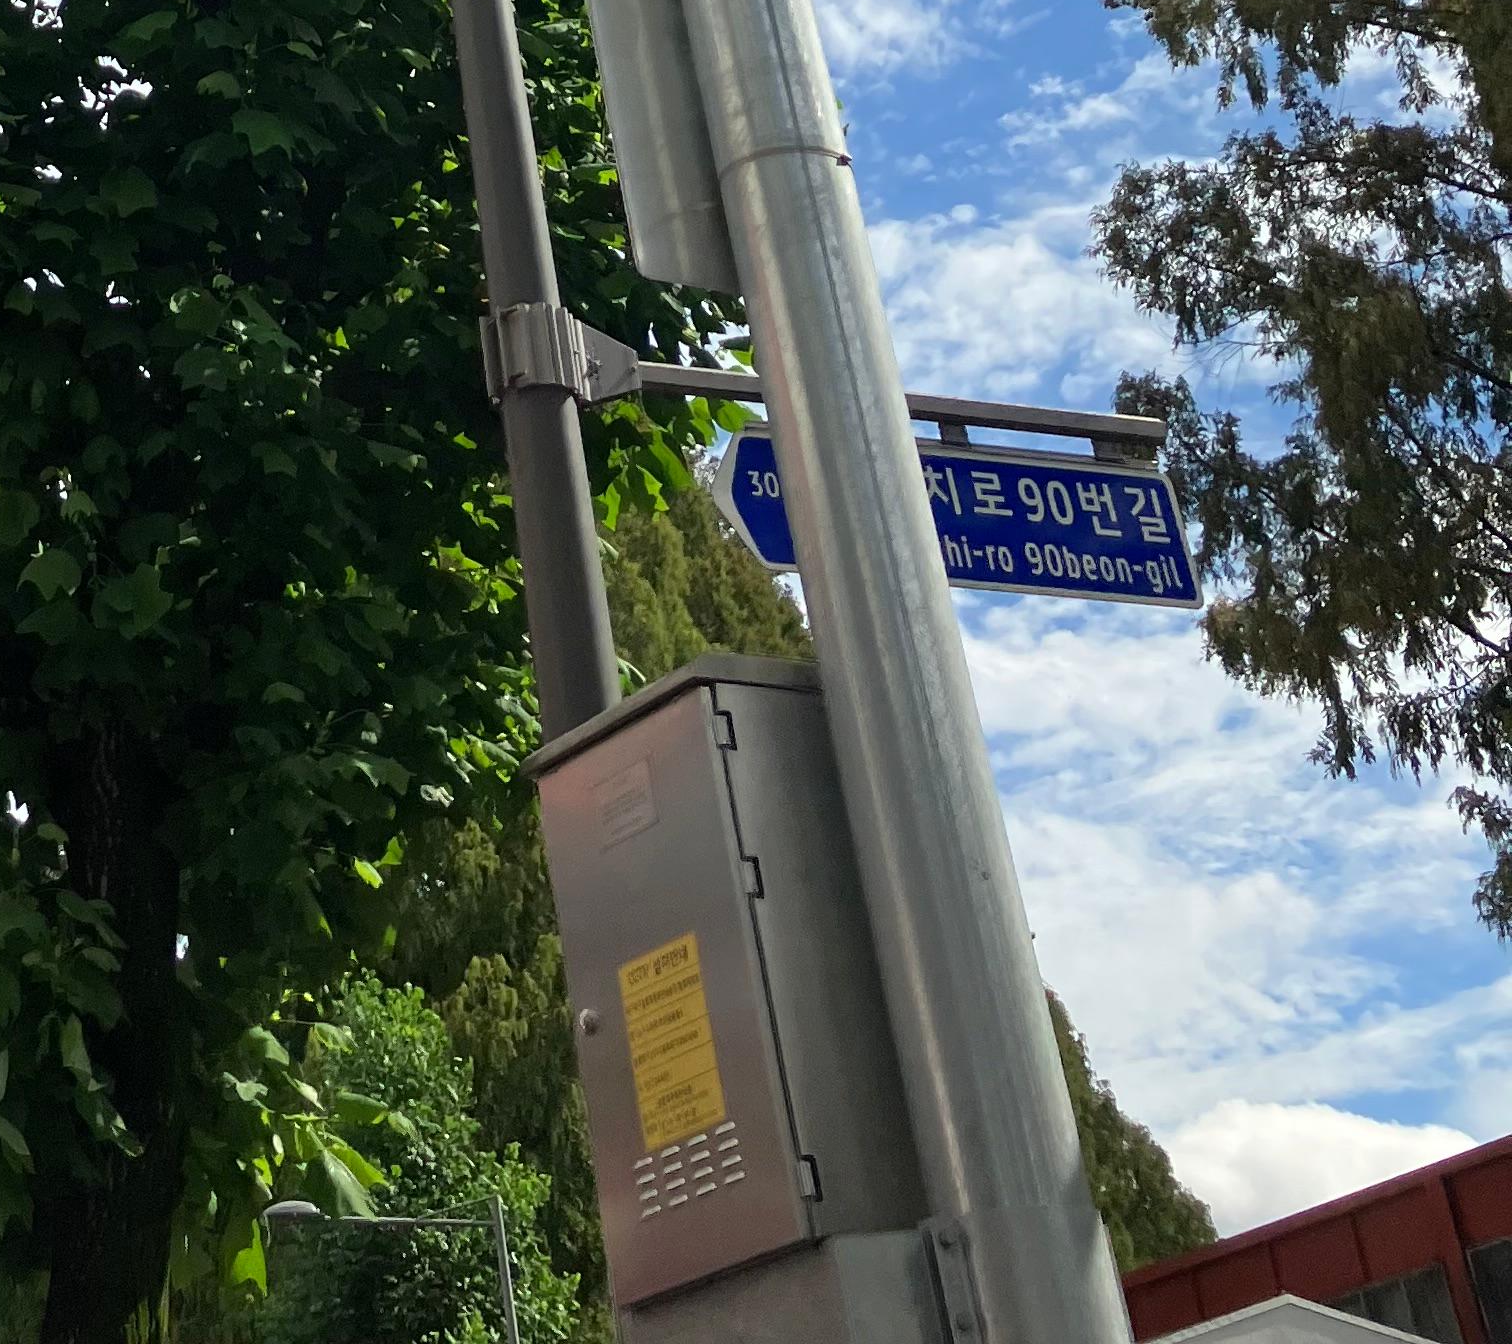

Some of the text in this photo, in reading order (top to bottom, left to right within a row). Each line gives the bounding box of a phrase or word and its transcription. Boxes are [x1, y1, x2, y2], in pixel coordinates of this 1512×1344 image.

[924, 464, 1172, 545] 치로90번길
[943, 534, 1184, 595] hi-ro 90beon-gil
